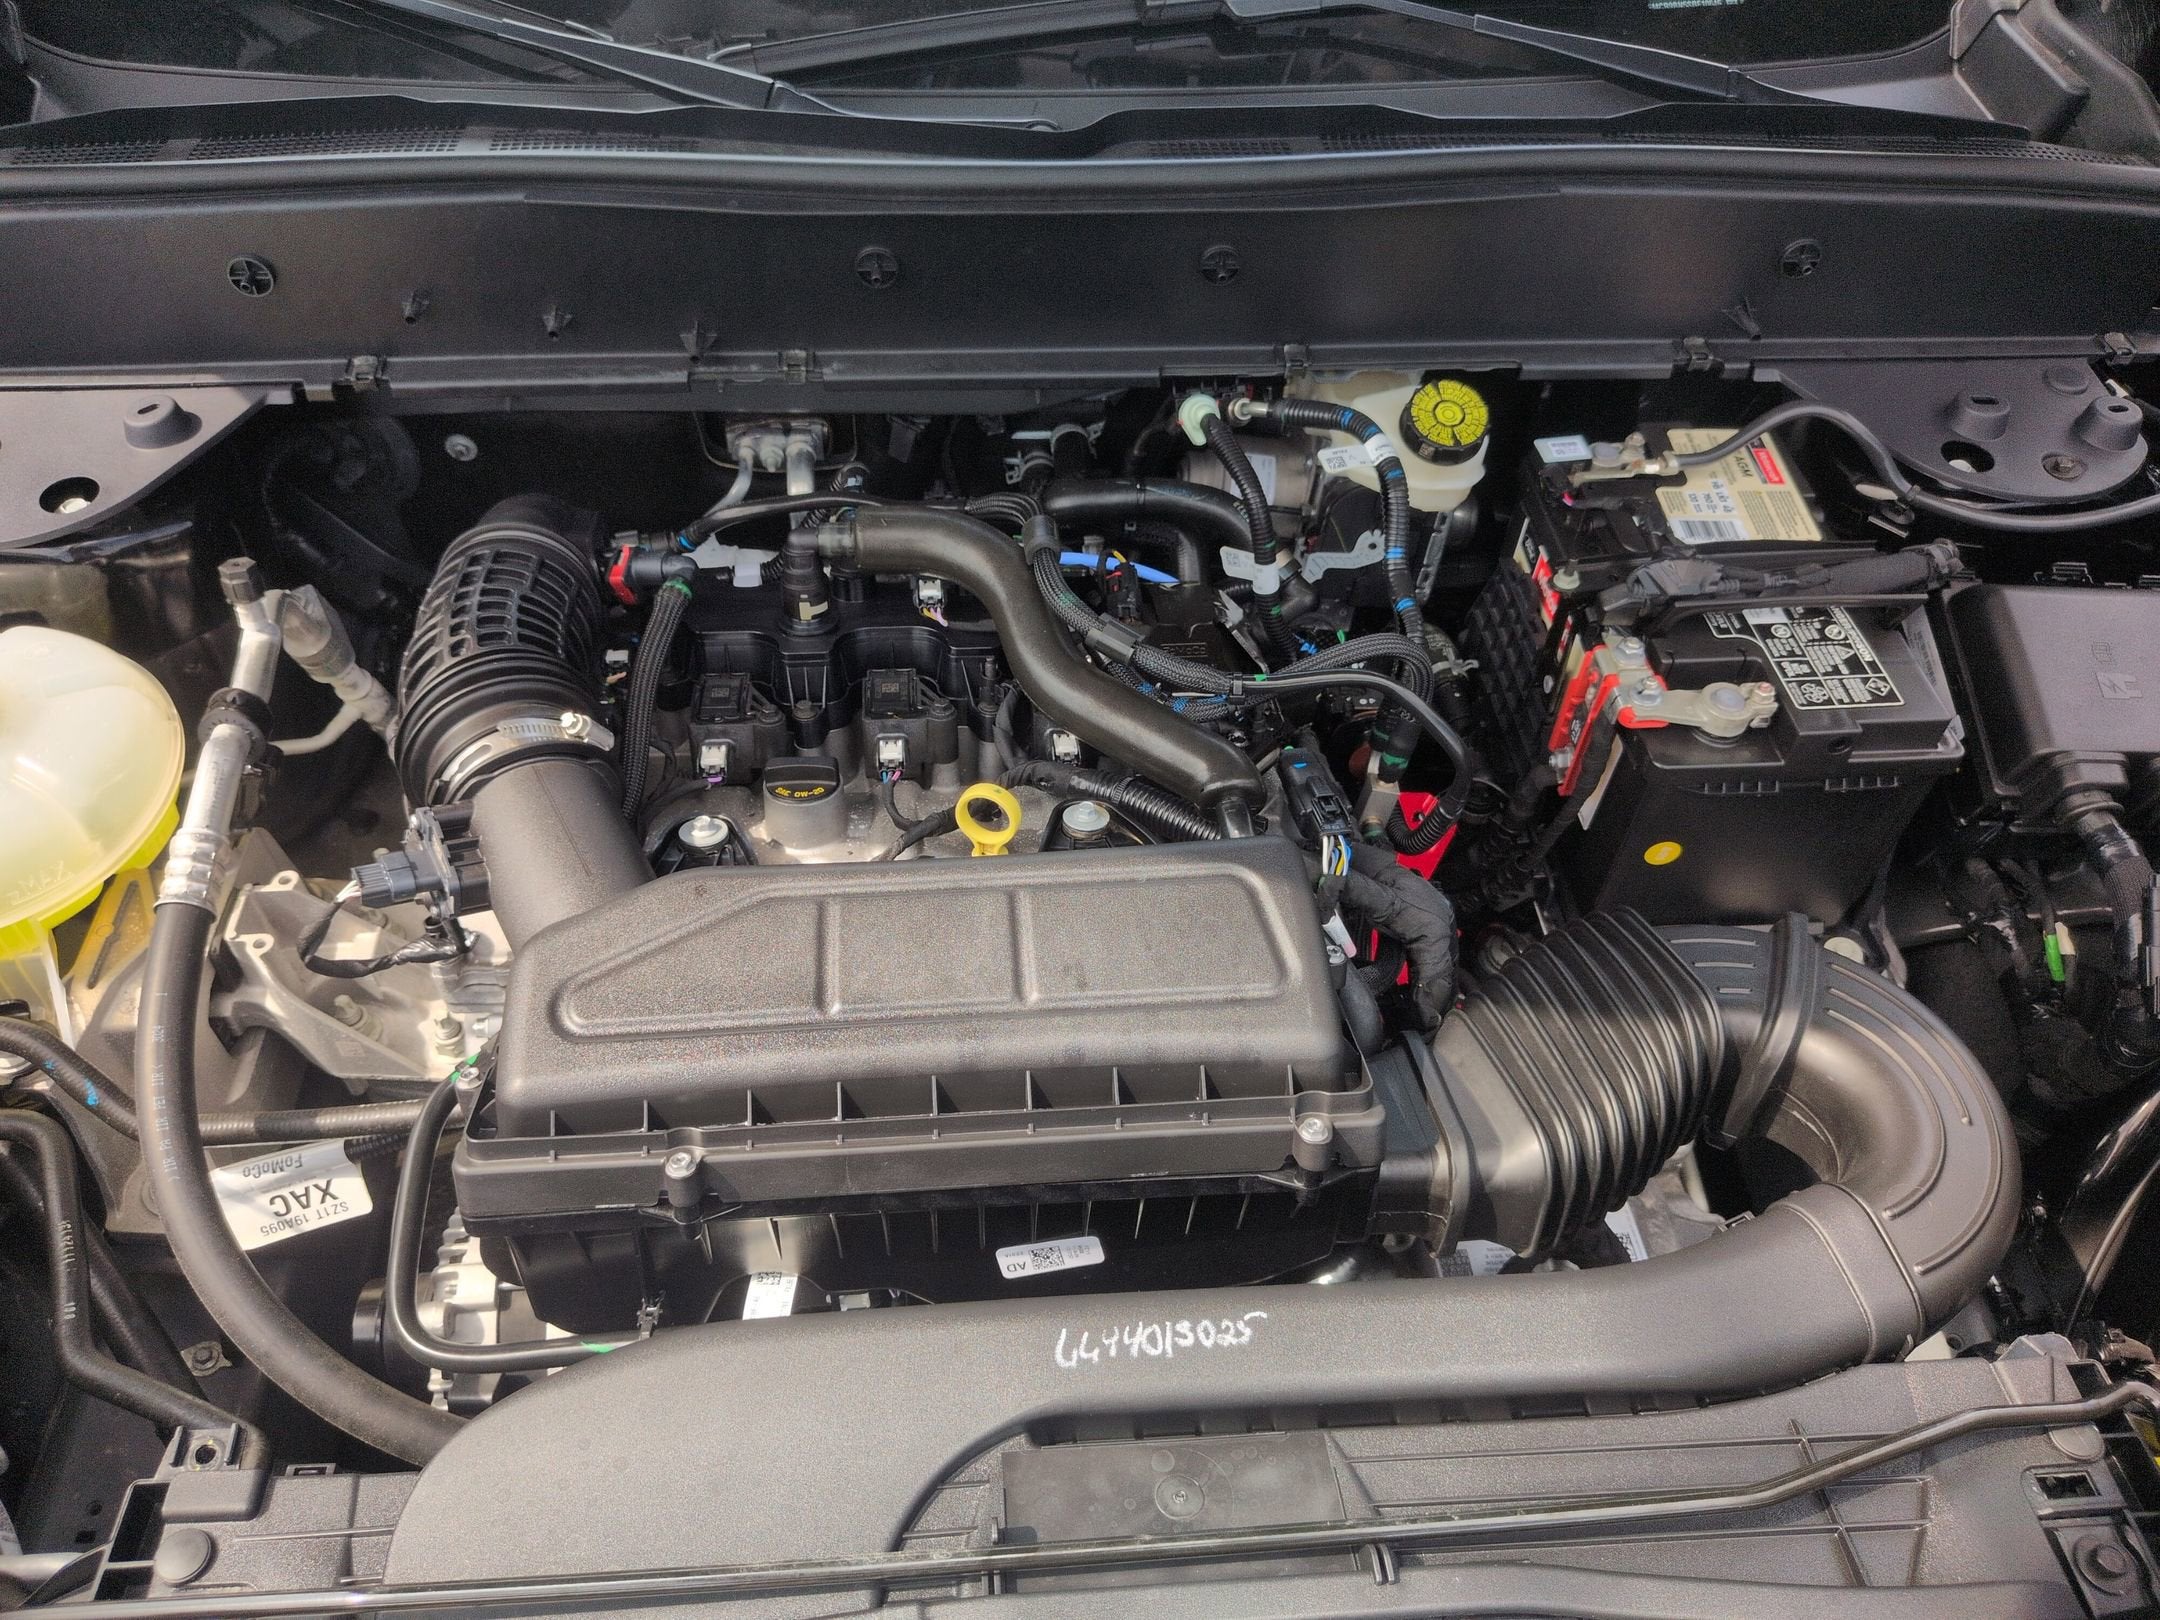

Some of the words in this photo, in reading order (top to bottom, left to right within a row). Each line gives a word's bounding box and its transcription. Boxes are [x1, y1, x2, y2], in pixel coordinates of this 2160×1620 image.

[1734, 456, 1753, 479] AGM
[775, 787, 791, 797] SAE
[242, 1153, 304, 1179] FoMoCo
[269, 1178, 339, 1217] XAC
[260, 1214, 310, 1237] 19A095
[1005, 1260, 1028, 1273] AD
